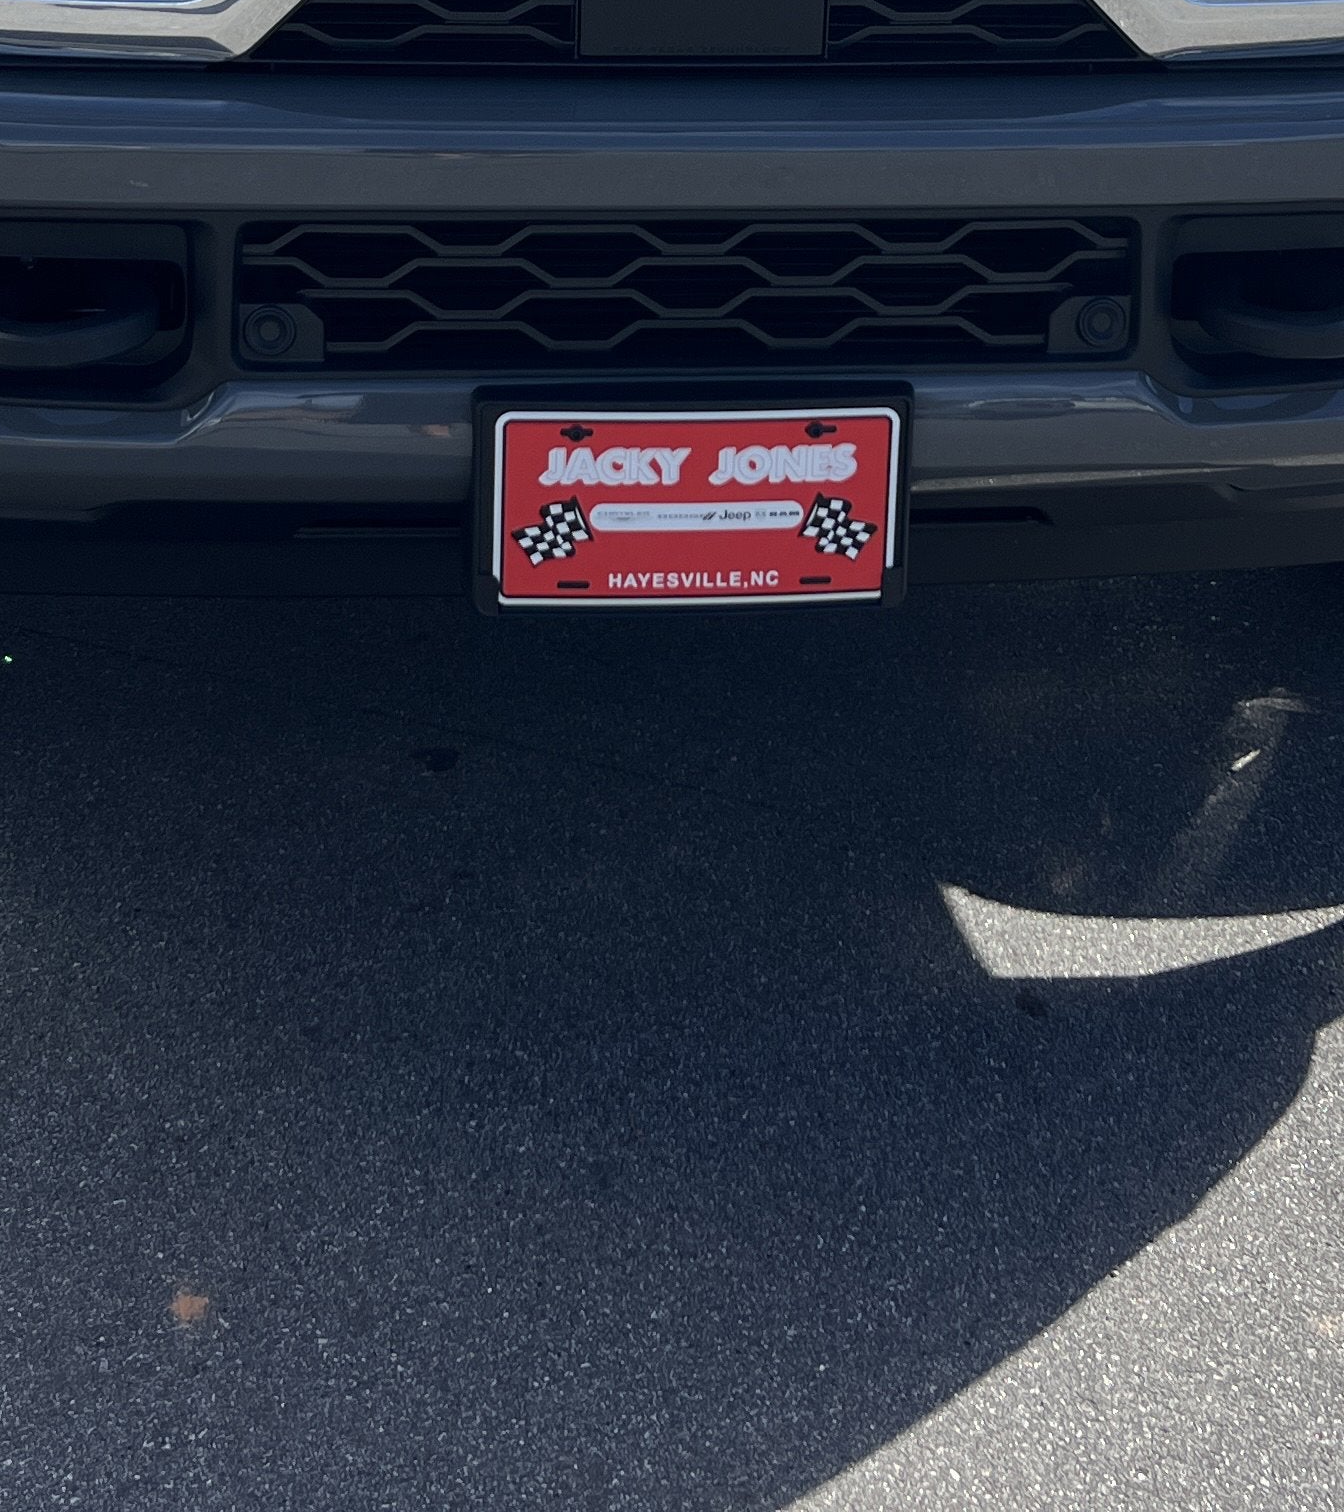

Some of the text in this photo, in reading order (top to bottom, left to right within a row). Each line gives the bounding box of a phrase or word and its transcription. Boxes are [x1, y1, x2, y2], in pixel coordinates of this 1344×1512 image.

[539, 443, 857, 486] JACKY JONES
[719, 509, 751, 521] Jeep
